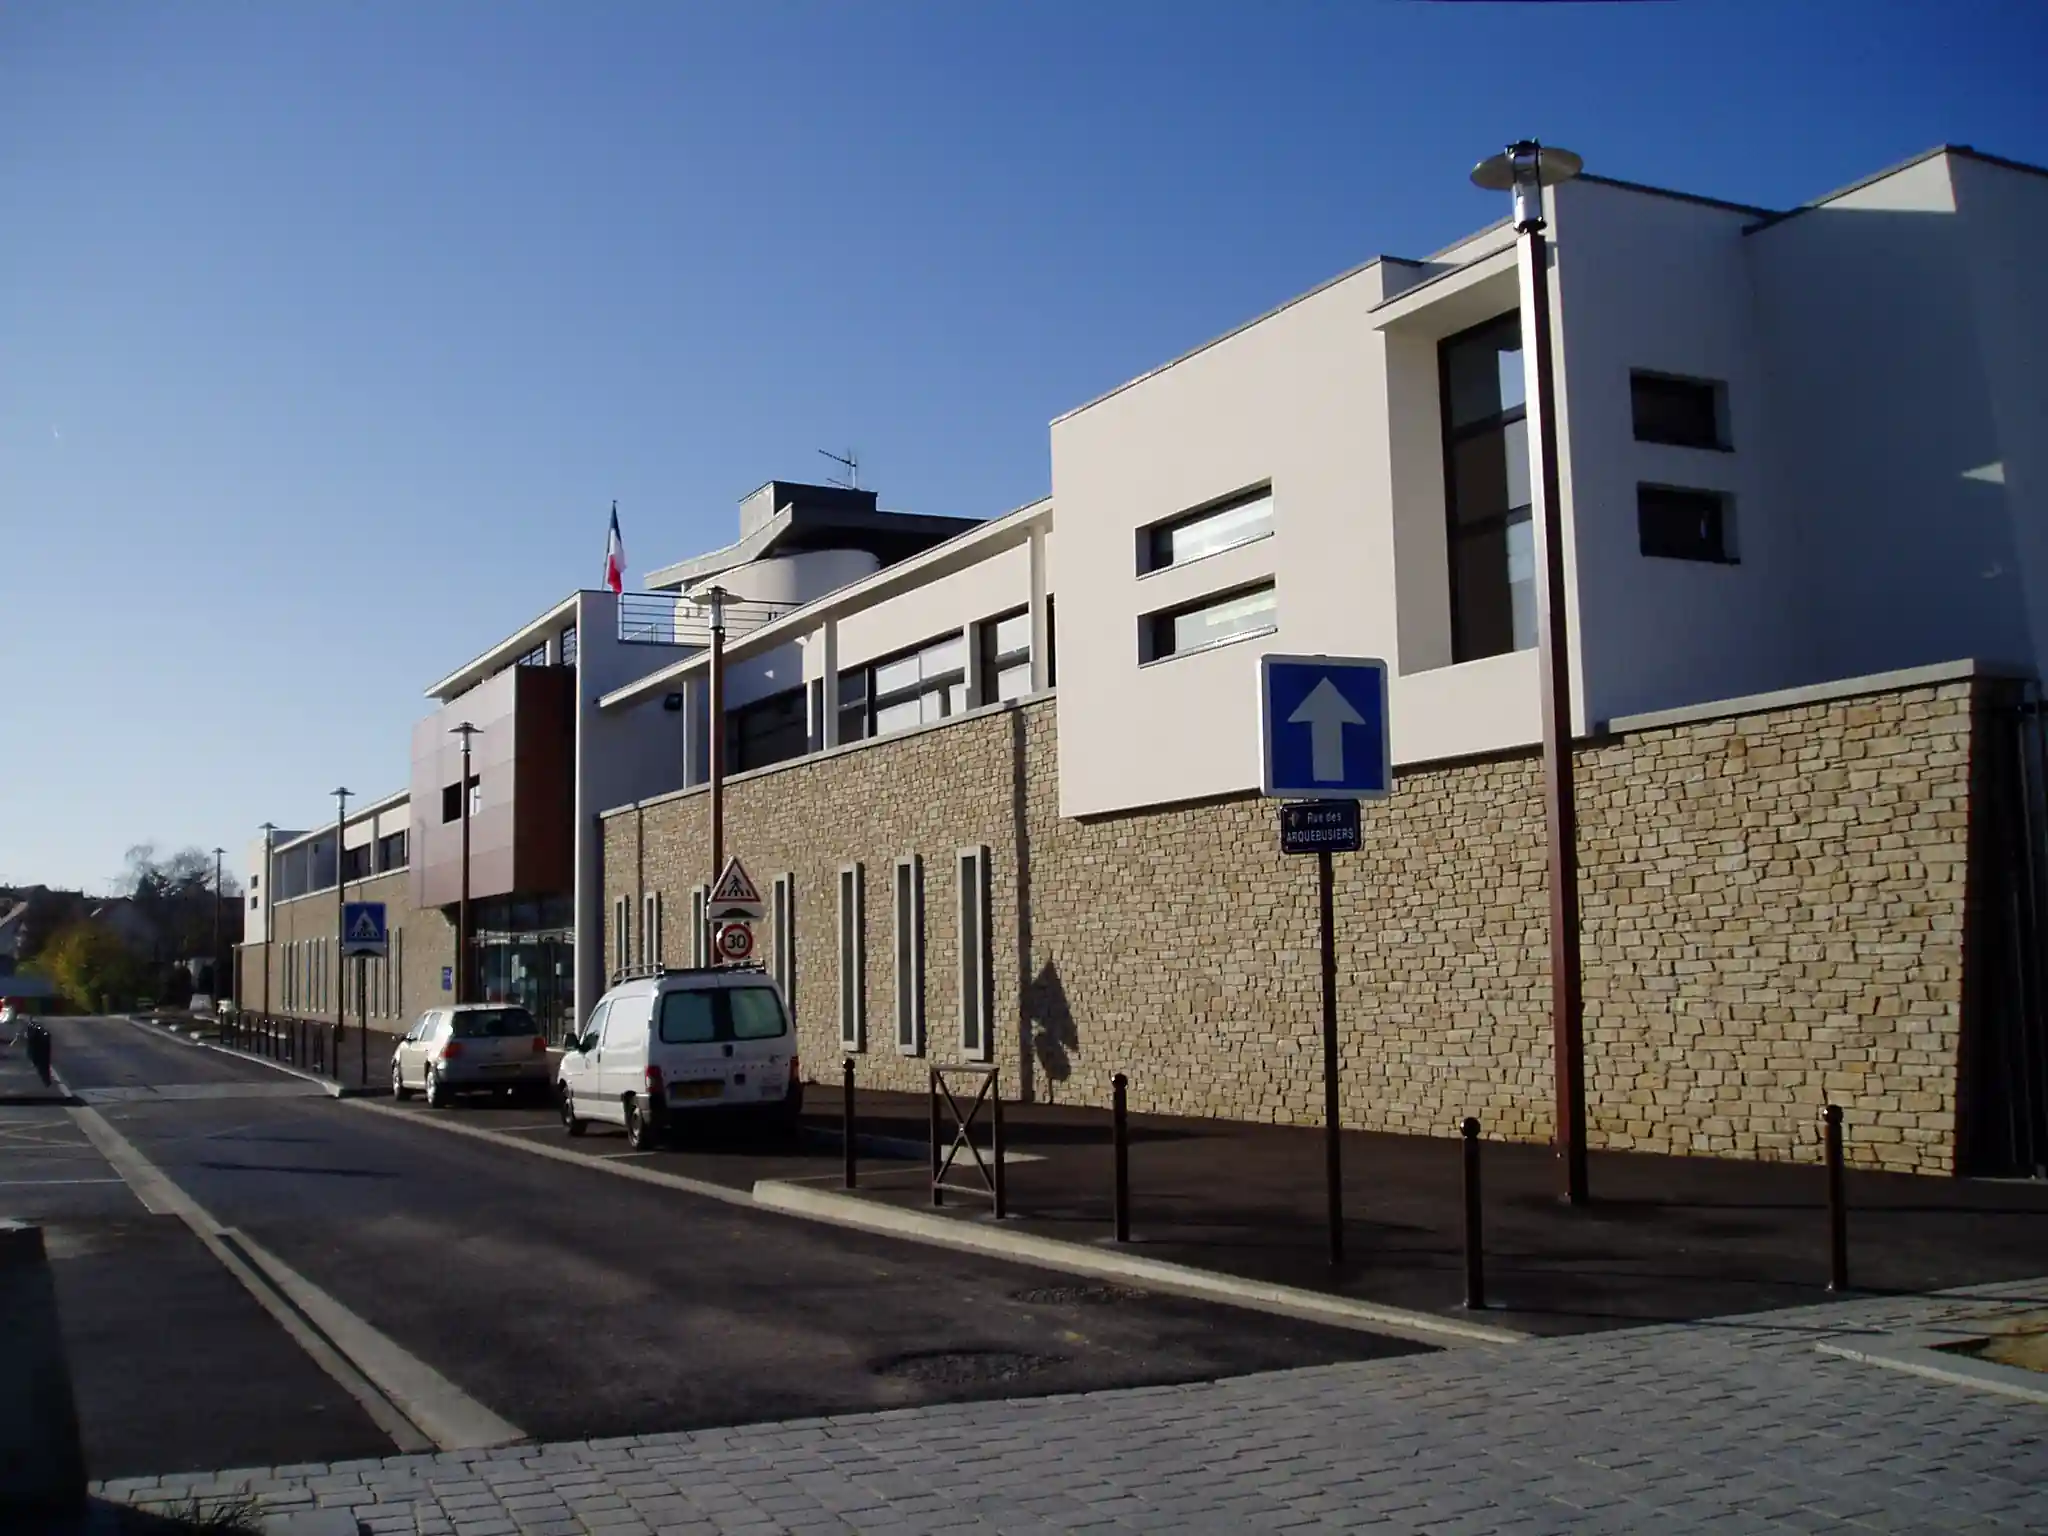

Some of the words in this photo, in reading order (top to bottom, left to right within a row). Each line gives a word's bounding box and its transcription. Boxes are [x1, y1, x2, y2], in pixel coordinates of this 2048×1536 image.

[1307, 811, 1324, 825] Rue
[1327, 811, 1342, 823] des
[1286, 828, 1355, 843] ARQUEBUSIERS
[727, 934, 747, 949] 30
